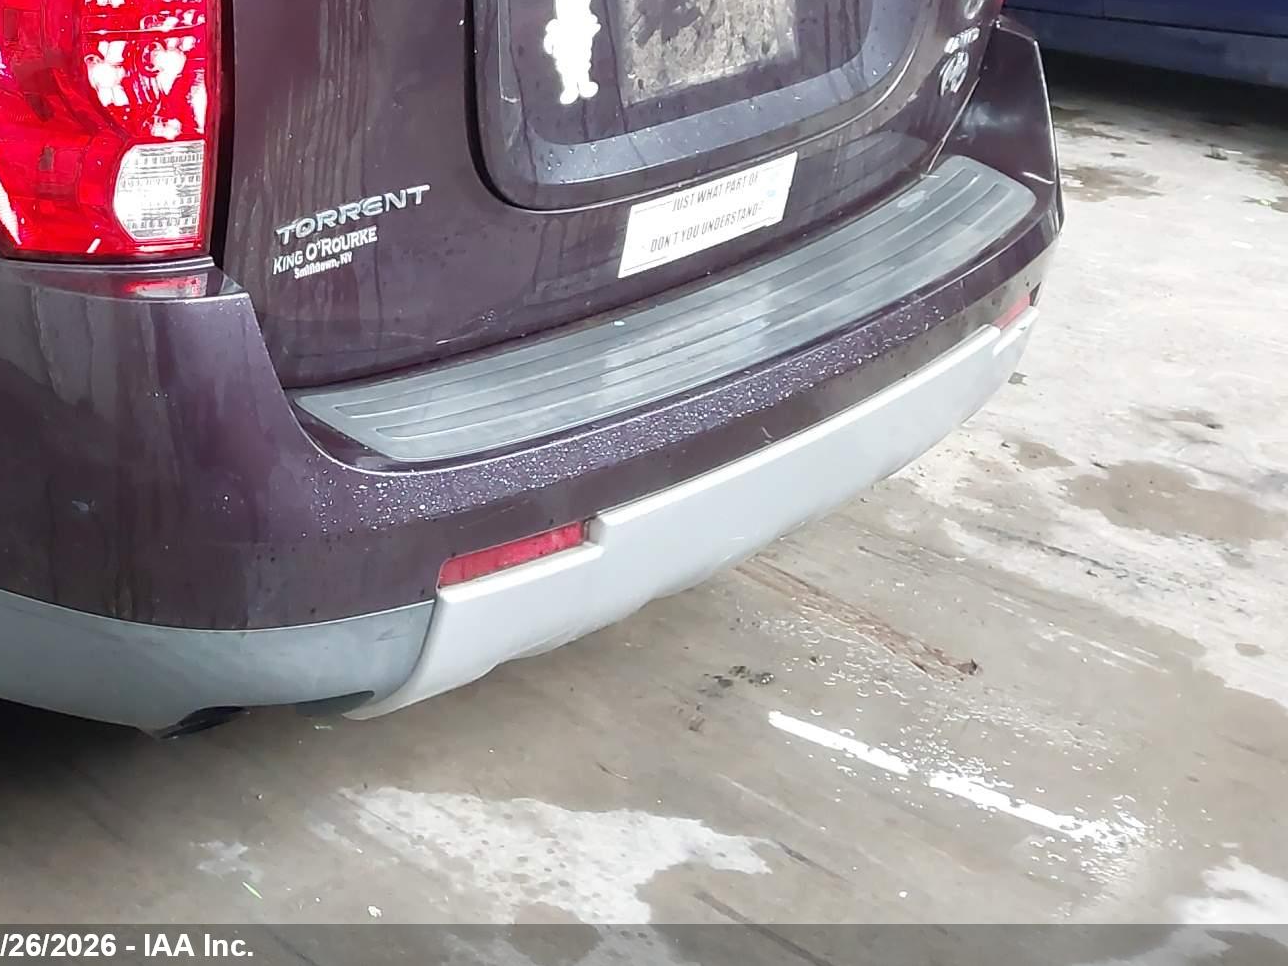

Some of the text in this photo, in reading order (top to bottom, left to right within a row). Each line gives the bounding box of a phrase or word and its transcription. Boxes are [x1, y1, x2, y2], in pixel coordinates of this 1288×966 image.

[276, 184, 430, 245] TORRENT
[671, 194, 696, 212] JUST
[697, 184, 724, 204] WHAT
[724, 175, 748, 194] PART
[273, 225, 378, 275] KING O'ROURKE
[680, 224, 700, 242] YOU
